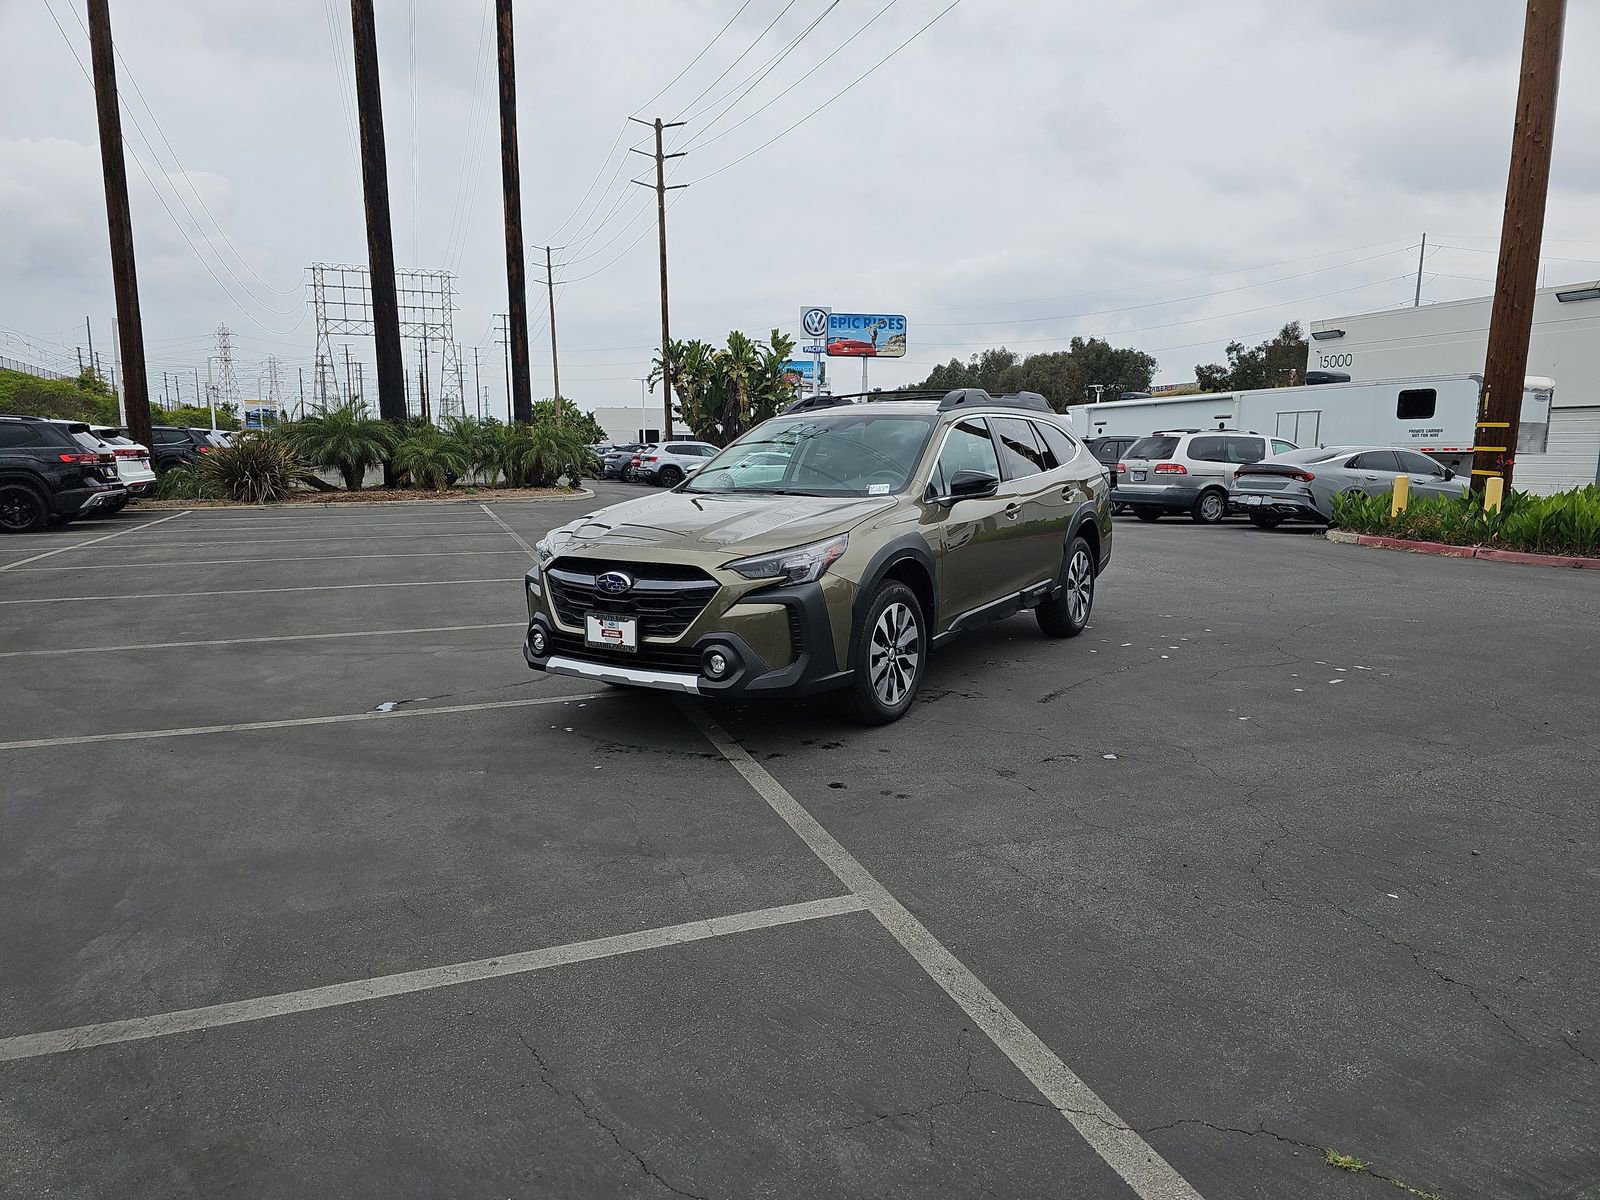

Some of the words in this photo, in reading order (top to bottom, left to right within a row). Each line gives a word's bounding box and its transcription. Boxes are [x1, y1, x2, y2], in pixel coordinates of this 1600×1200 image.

[830, 316, 860, 329] EPIC
[863, 318, 904, 330] RIDES
[1320, 353, 1353, 368] 15000
